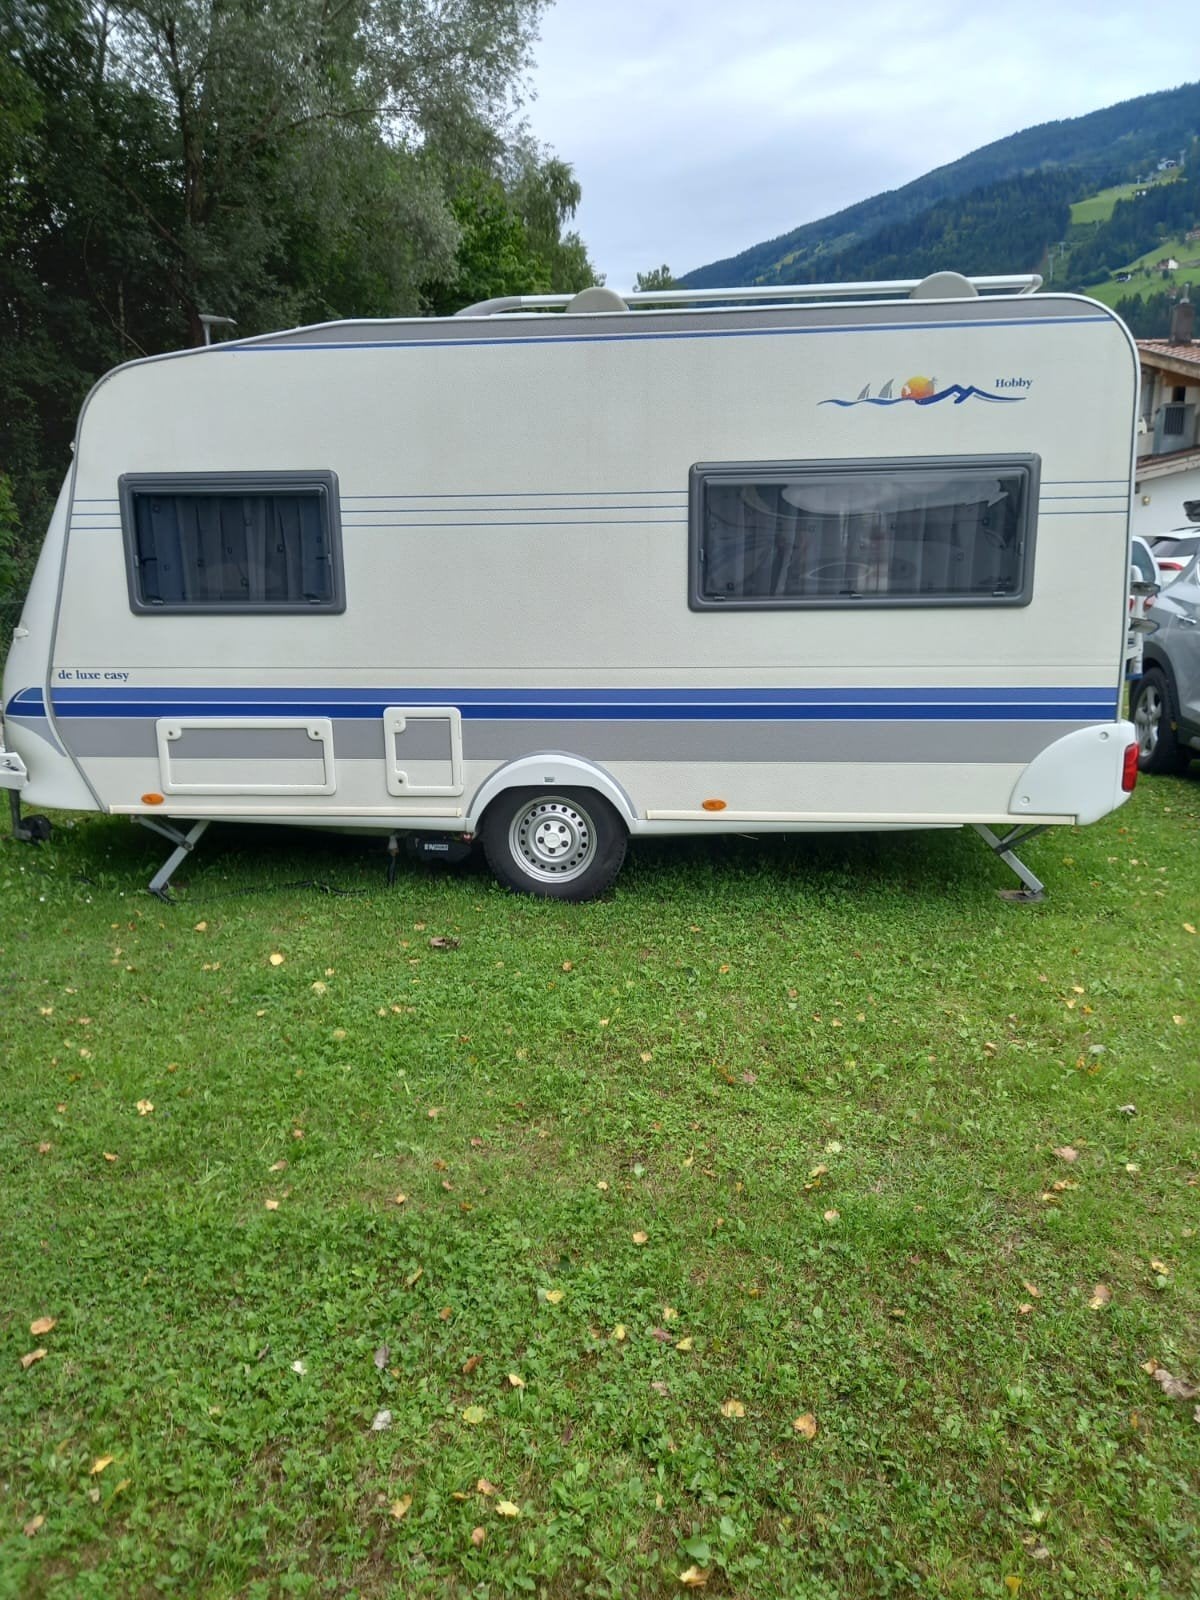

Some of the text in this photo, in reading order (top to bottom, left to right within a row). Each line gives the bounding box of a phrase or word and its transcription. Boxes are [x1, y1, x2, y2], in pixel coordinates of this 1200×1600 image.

[995, 377, 1033, 390] Hobby
[58, 669, 129, 683] de luxe easy
